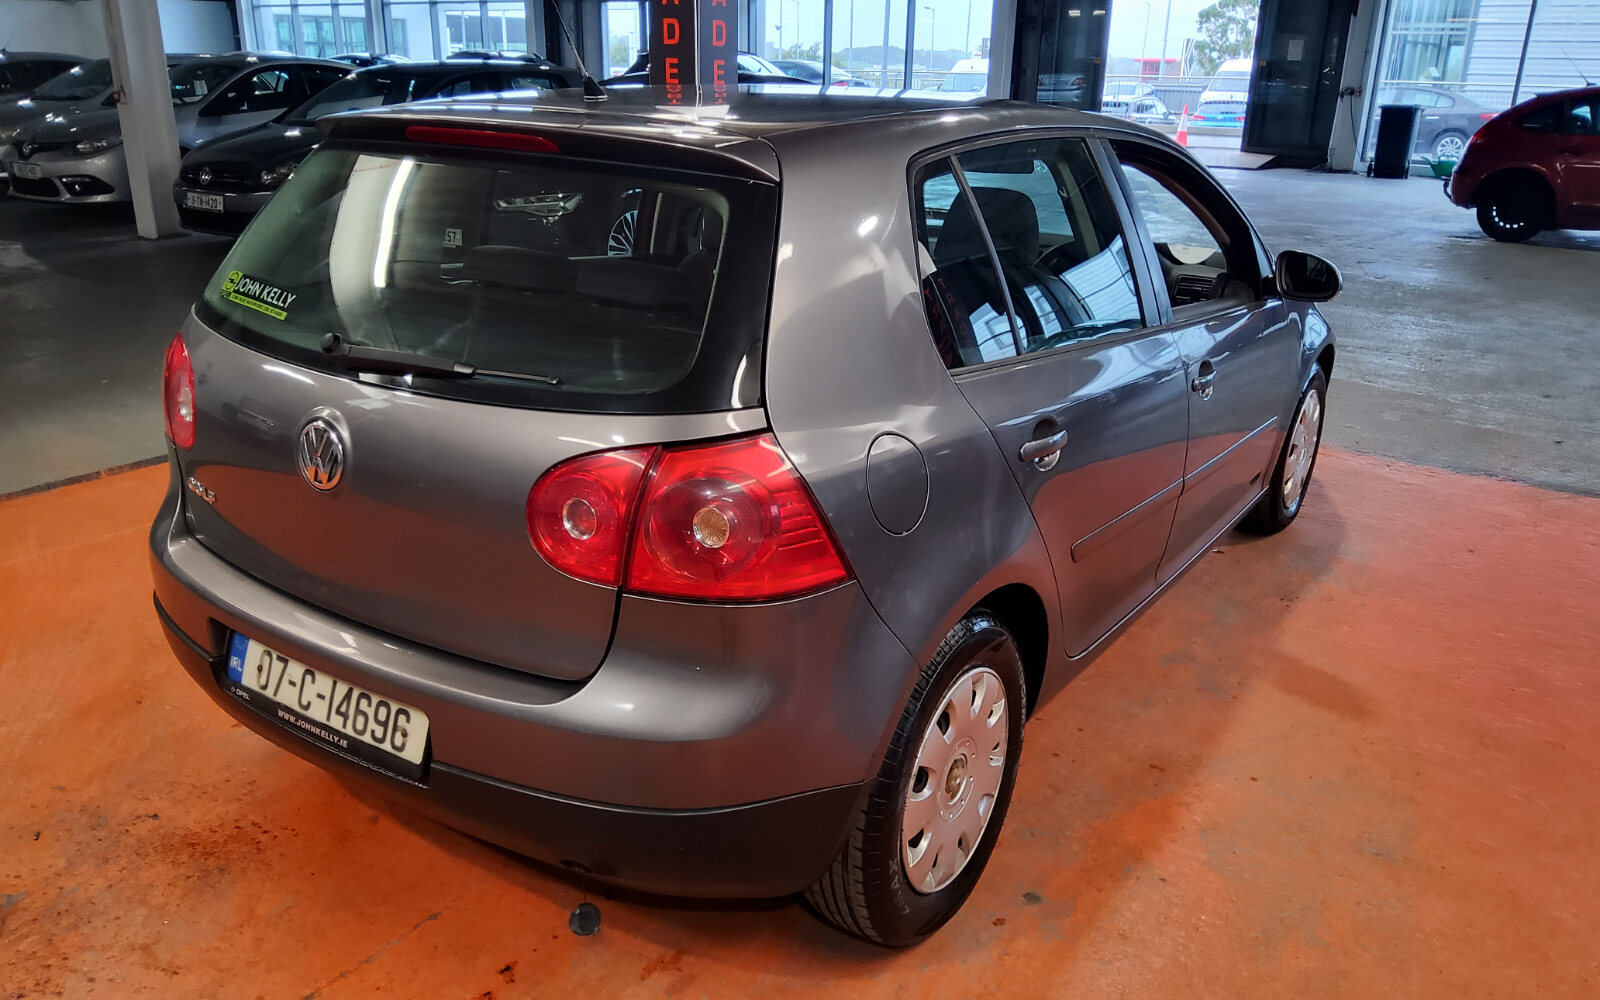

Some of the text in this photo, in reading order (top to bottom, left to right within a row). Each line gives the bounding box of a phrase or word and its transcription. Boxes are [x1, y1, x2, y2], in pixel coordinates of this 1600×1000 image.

[662, 0, 680, 84] DE
[712, 0, 727, 86] DE
[235, 277, 265, 298] JOHN
[260, 286, 297, 309] KELLY
[230, 656, 243, 672] IRL
[257, 650, 411, 753] 07-C-14696
[277, 709, 349, 749] WWW.JOHNKELLY.IE
